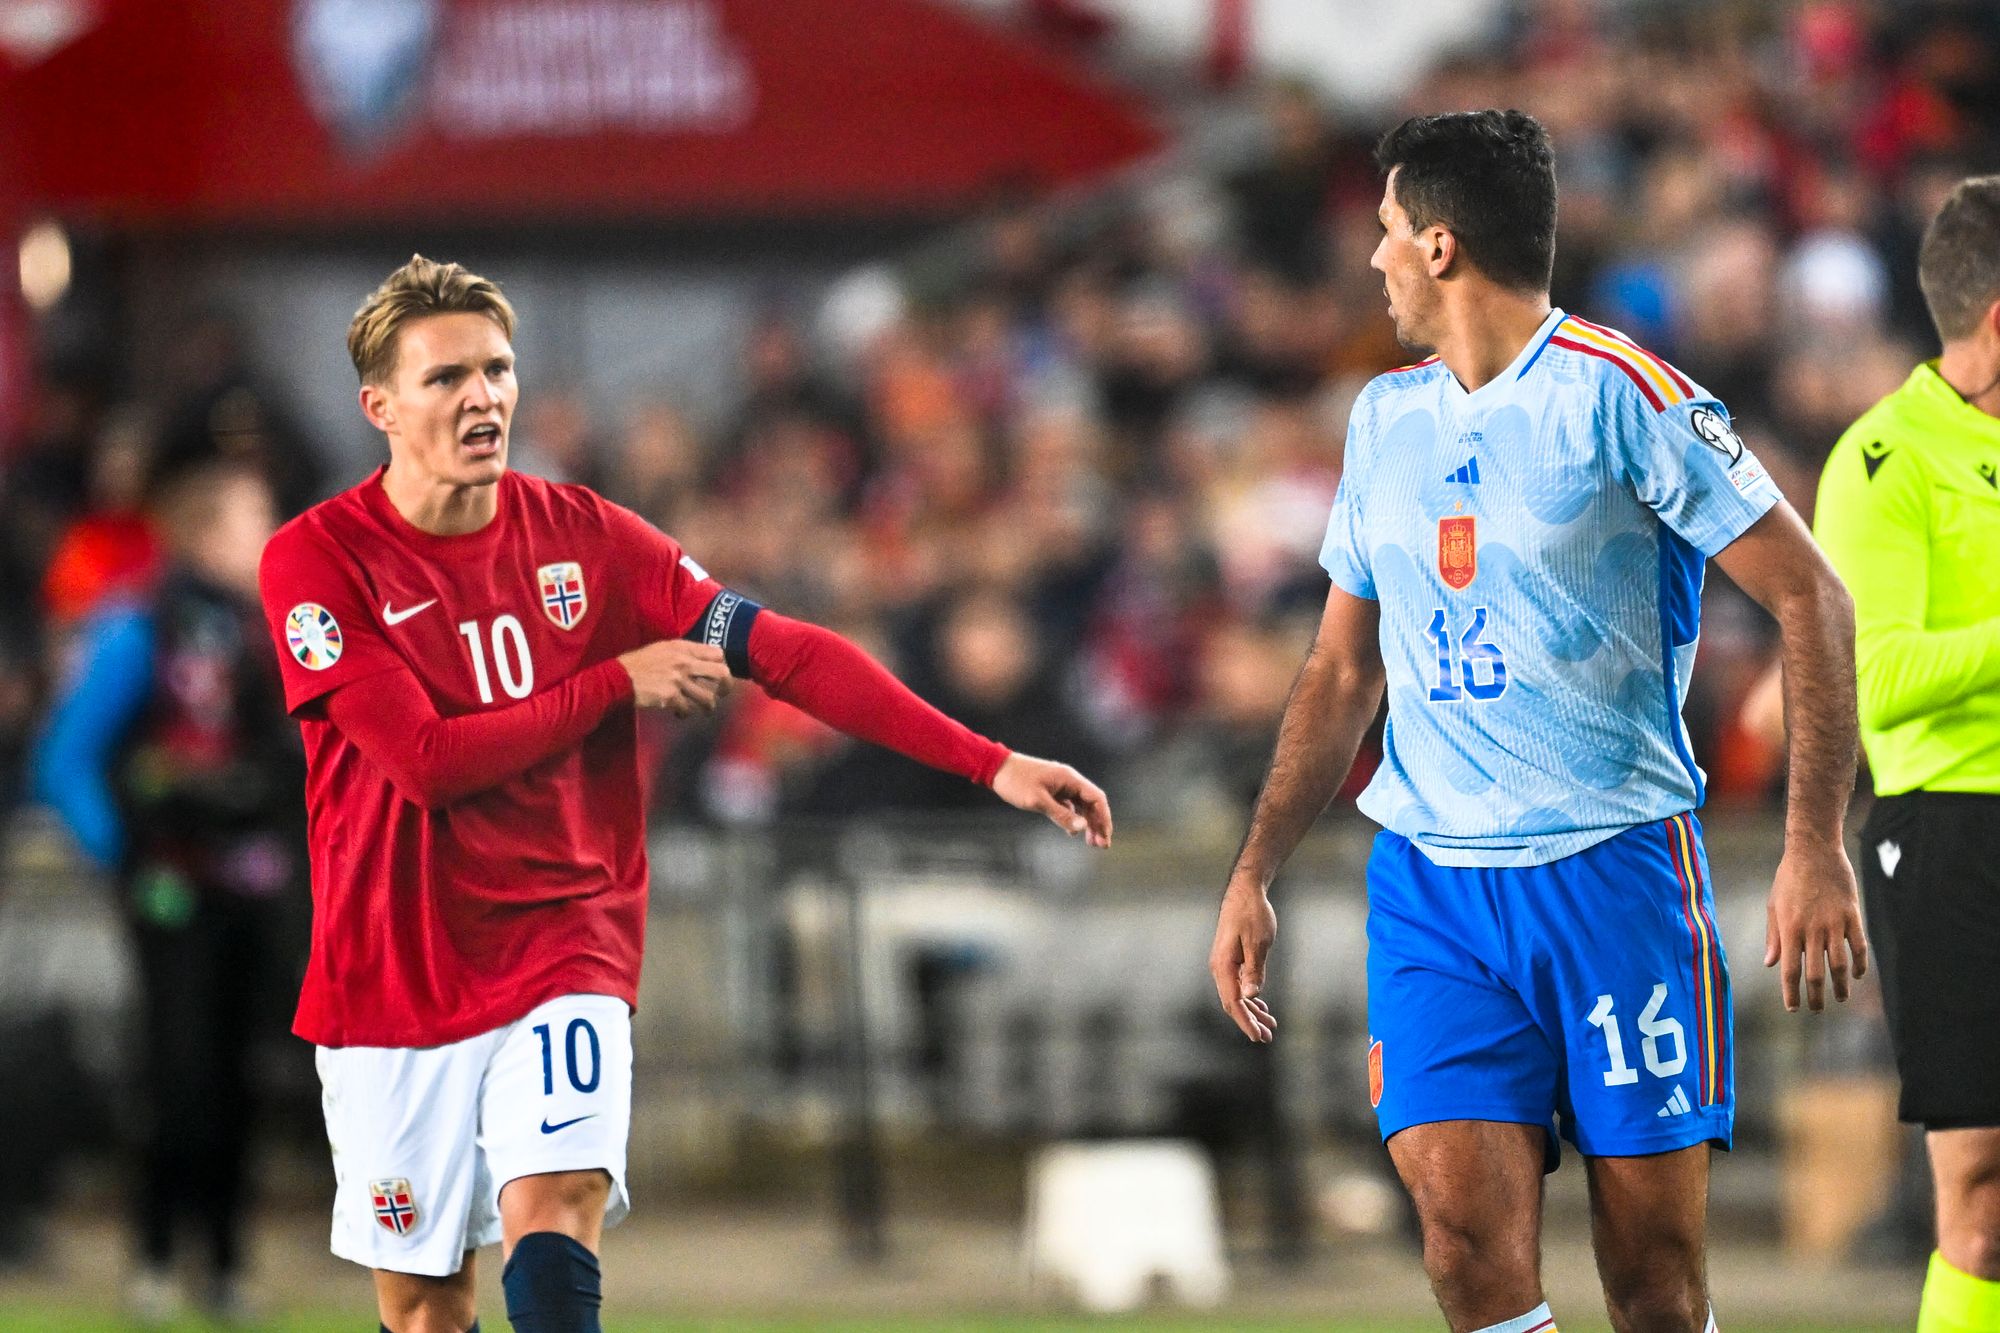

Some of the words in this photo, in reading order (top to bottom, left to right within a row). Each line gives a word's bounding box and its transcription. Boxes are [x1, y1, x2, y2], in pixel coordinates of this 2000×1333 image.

[459, 614, 534, 703] 10
[1424, 606, 1508, 703] 16
[532, 1018, 601, 1095] 10
[1587, 983, 1687, 1086] 16
